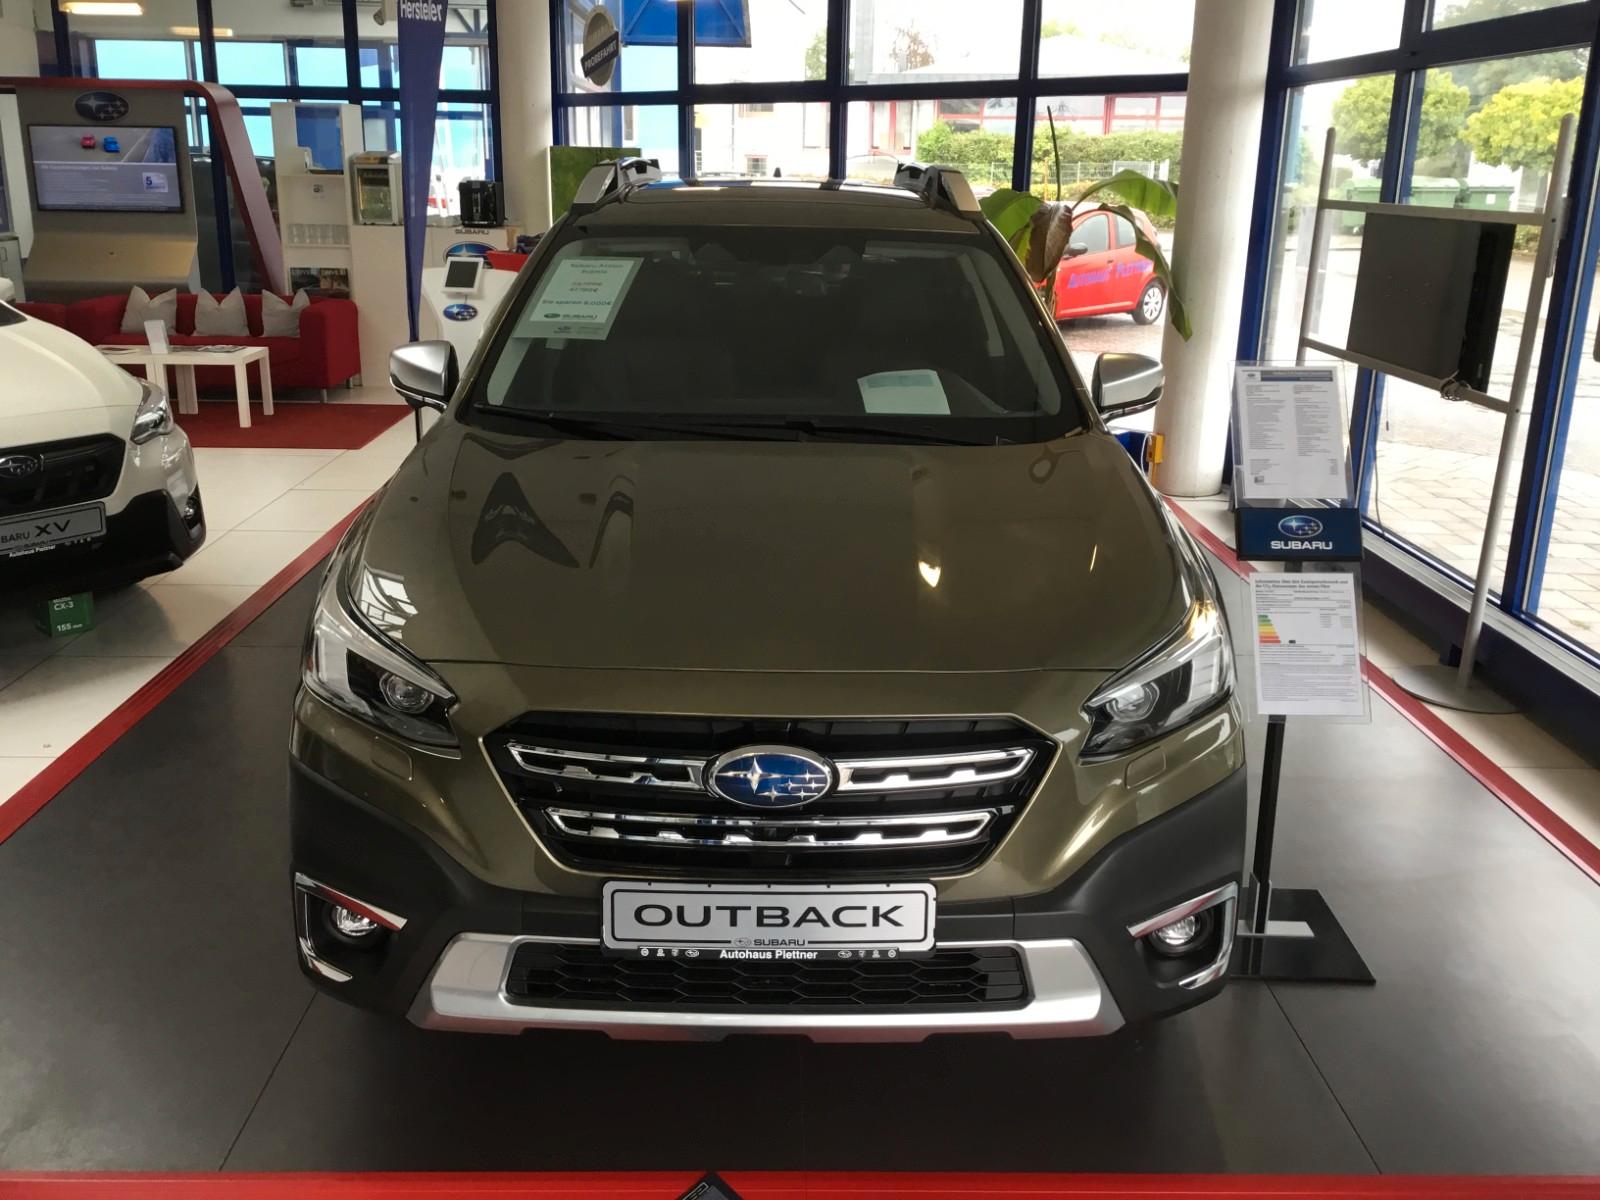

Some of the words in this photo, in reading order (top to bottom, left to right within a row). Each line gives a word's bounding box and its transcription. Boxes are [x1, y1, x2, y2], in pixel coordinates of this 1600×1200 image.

[145, 176, 153, 186] 5
[35, 519, 72, 538] XV
[1270, 541, 1333, 551] SUBARU
[53, 601, 74, 611] CX-3
[56, 622, 72, 632] 155
[633, 903, 905, 929] OUTBACK
[753, 938, 807, 947] SUBARU
[719, 949, 772, 960] Autohaus
[774, 949, 819, 960] Plettner
